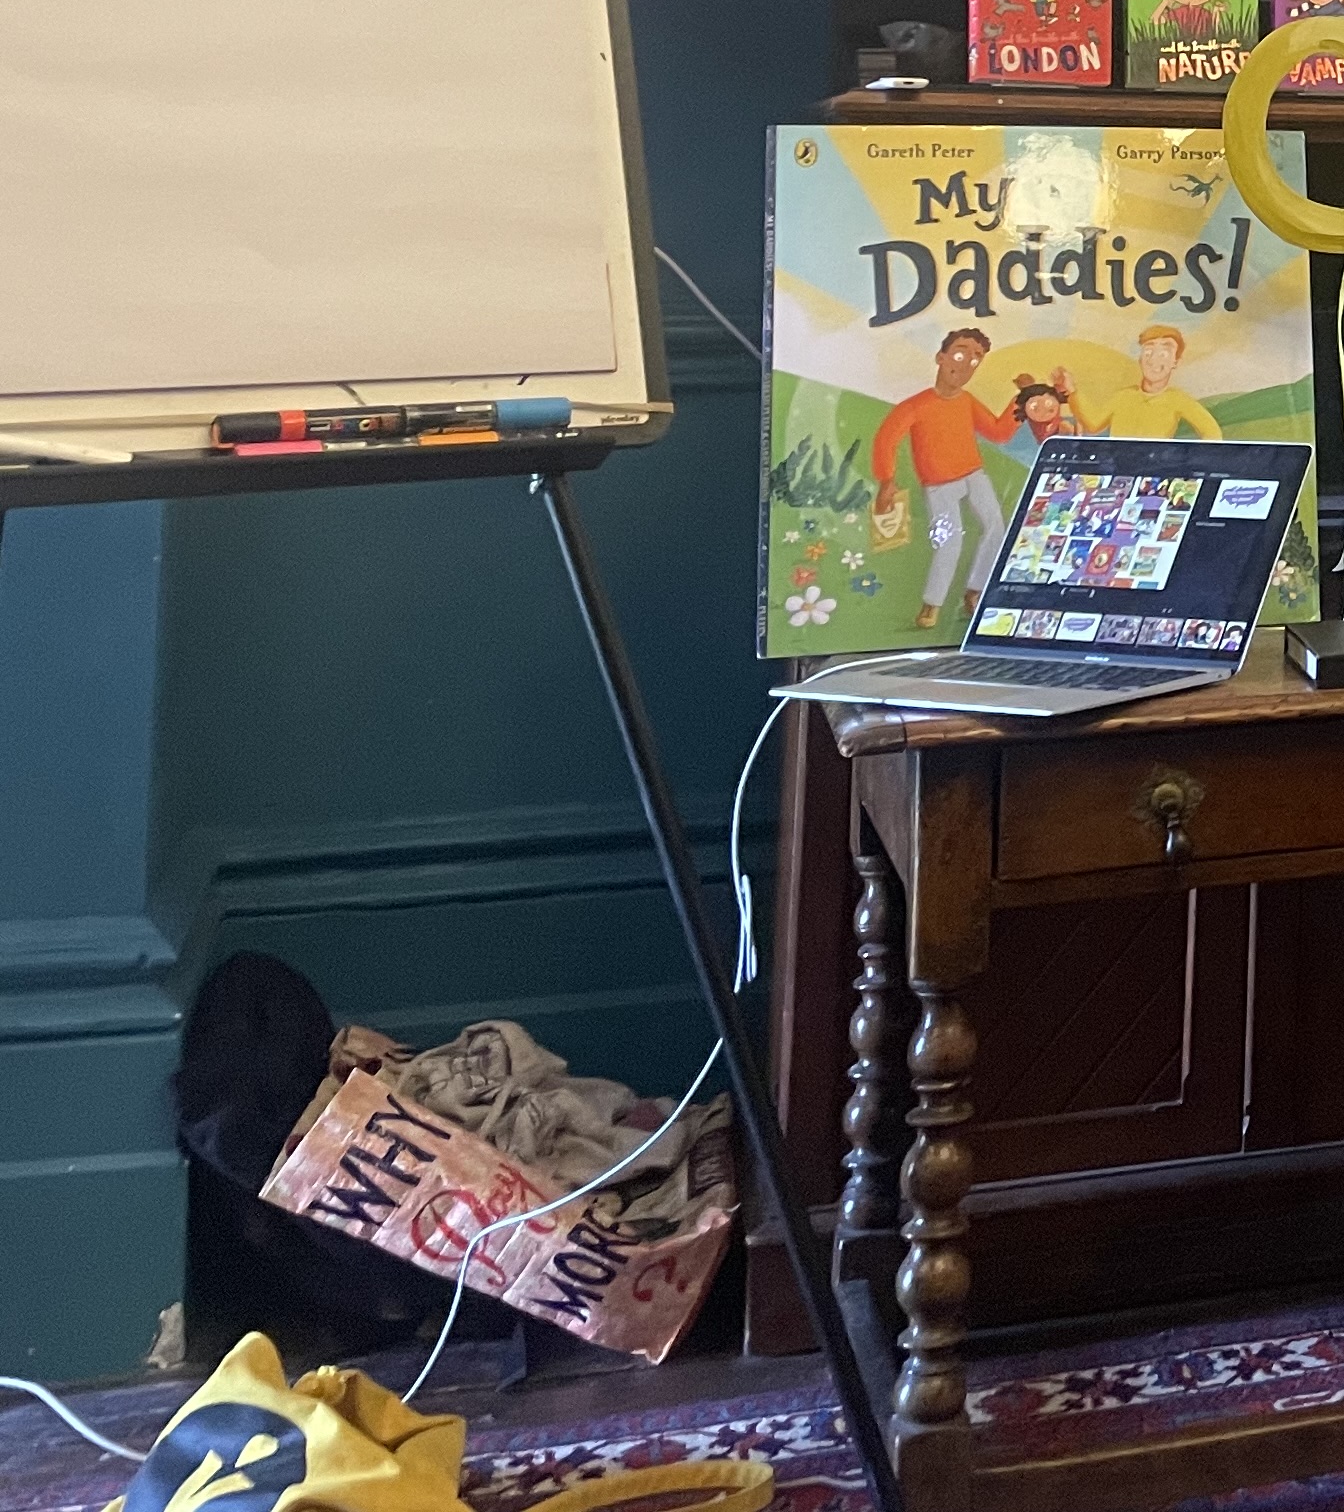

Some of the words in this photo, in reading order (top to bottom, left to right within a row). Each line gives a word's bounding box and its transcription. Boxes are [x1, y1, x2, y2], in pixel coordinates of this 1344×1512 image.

[988, 40, 1101, 75] LONDON
[866, 143, 926, 161] Gareth
[931, 143, 976, 161] Peter
[1116, 144, 1166, 165] Garry
[1170, 144, 1227, 163] Parson
[912, 170, 1013, 232] My
[858, 217, 1251, 328] Daddies!
[309, 1093, 451, 1226] WHY
